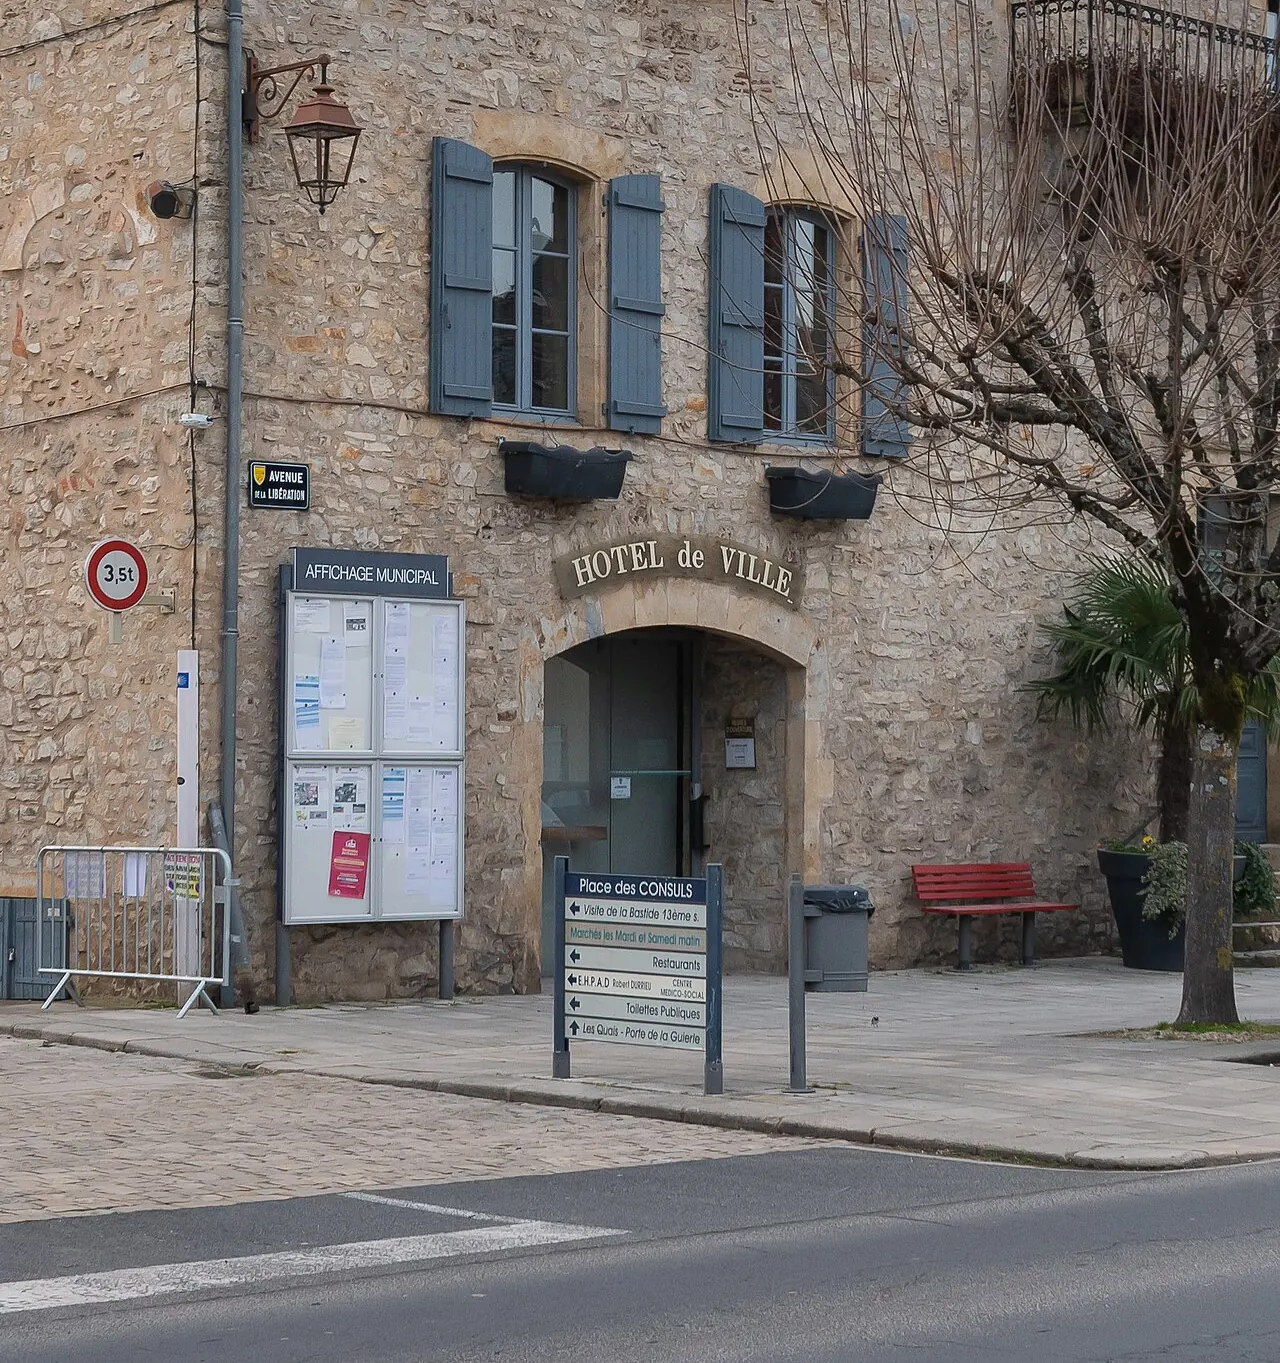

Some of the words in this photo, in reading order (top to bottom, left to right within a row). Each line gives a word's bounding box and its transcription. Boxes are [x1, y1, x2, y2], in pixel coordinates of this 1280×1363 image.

[269, 470, 304, 484] AVENUE
[254, 490, 260, 499] DE
[260, 490, 266, 499] LA
[268, 487, 305, 501] LIBÉRATION
[103, 564, 135, 585] 3,5t
[305, 563, 374, 582] AFFICHAGE
[376, 567, 439, 585] MUNICIPAL
[571, 540, 664, 588] HOTEL
[677, 540, 705, 569] de
[720, 545, 793, 597] VILLE
[579, 878, 612, 893] Place
[615, 880, 636, 895] des
[639, 881, 693, 898] CONSULS
[583, 904, 605, 916] Visite
[606, 906, 617, 917] de
[620, 906, 627, 918] la
[629, 908, 660, 920] Bastide
[662, 909, 692, 921] 13ème
[693, 913, 700, 923] s.
[570, 927, 601, 940] Marchés
[603, 928, 613, 941] les
[615, 929, 637, 943] Mardi
[638, 931, 646, 943] et
[648, 932, 676, 945] Samedi
[679, 934, 700, 947] matin
[652, 956, 701, 971] Restaurants
[578, 975, 610, 988] E.H.P.A.D
[612, 978, 630, 989] Robert
[630, 980, 652, 991] DURRIEU
[672, 978, 693, 989] CENTRE
[626, 1002, 659, 1016] Toilettes
[660, 1005, 700, 1020] Publiques
[583, 1022, 595, 1035] Les
[597, 1024, 619, 1037] Quais
[625, 1026, 646, 1039] Porte
[647, 1029, 658, 1041] de
[660, 1029, 668, 1042] la
[670, 1031, 701, 1044] Guierle
